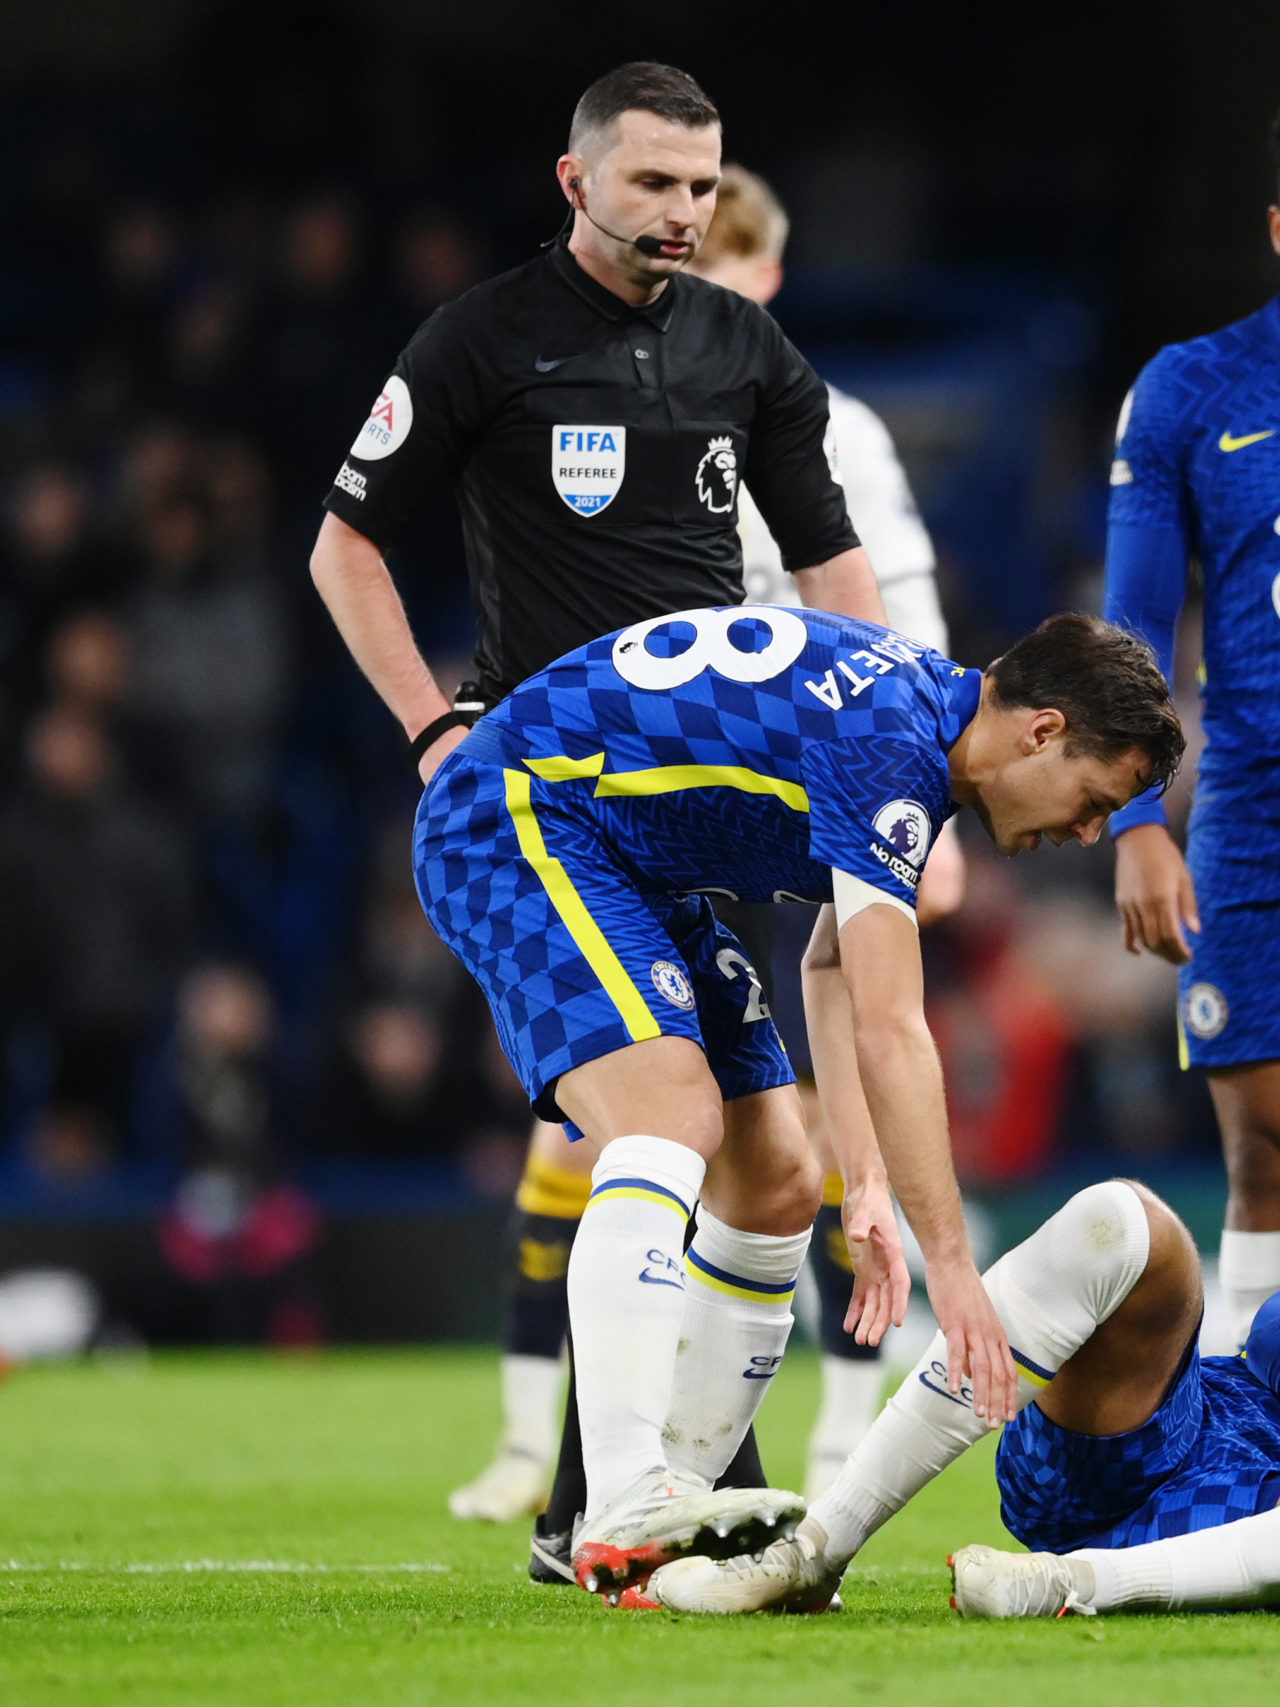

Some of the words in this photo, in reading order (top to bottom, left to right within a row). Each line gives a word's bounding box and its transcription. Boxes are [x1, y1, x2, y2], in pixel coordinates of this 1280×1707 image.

[559, 432, 617, 452] FIFA
[559, 467, 617, 479] REFEREE
[574, 496, 601, 508] 2021
[888, 856, 919, 883] room
[930, 1360, 973, 1403] CC
